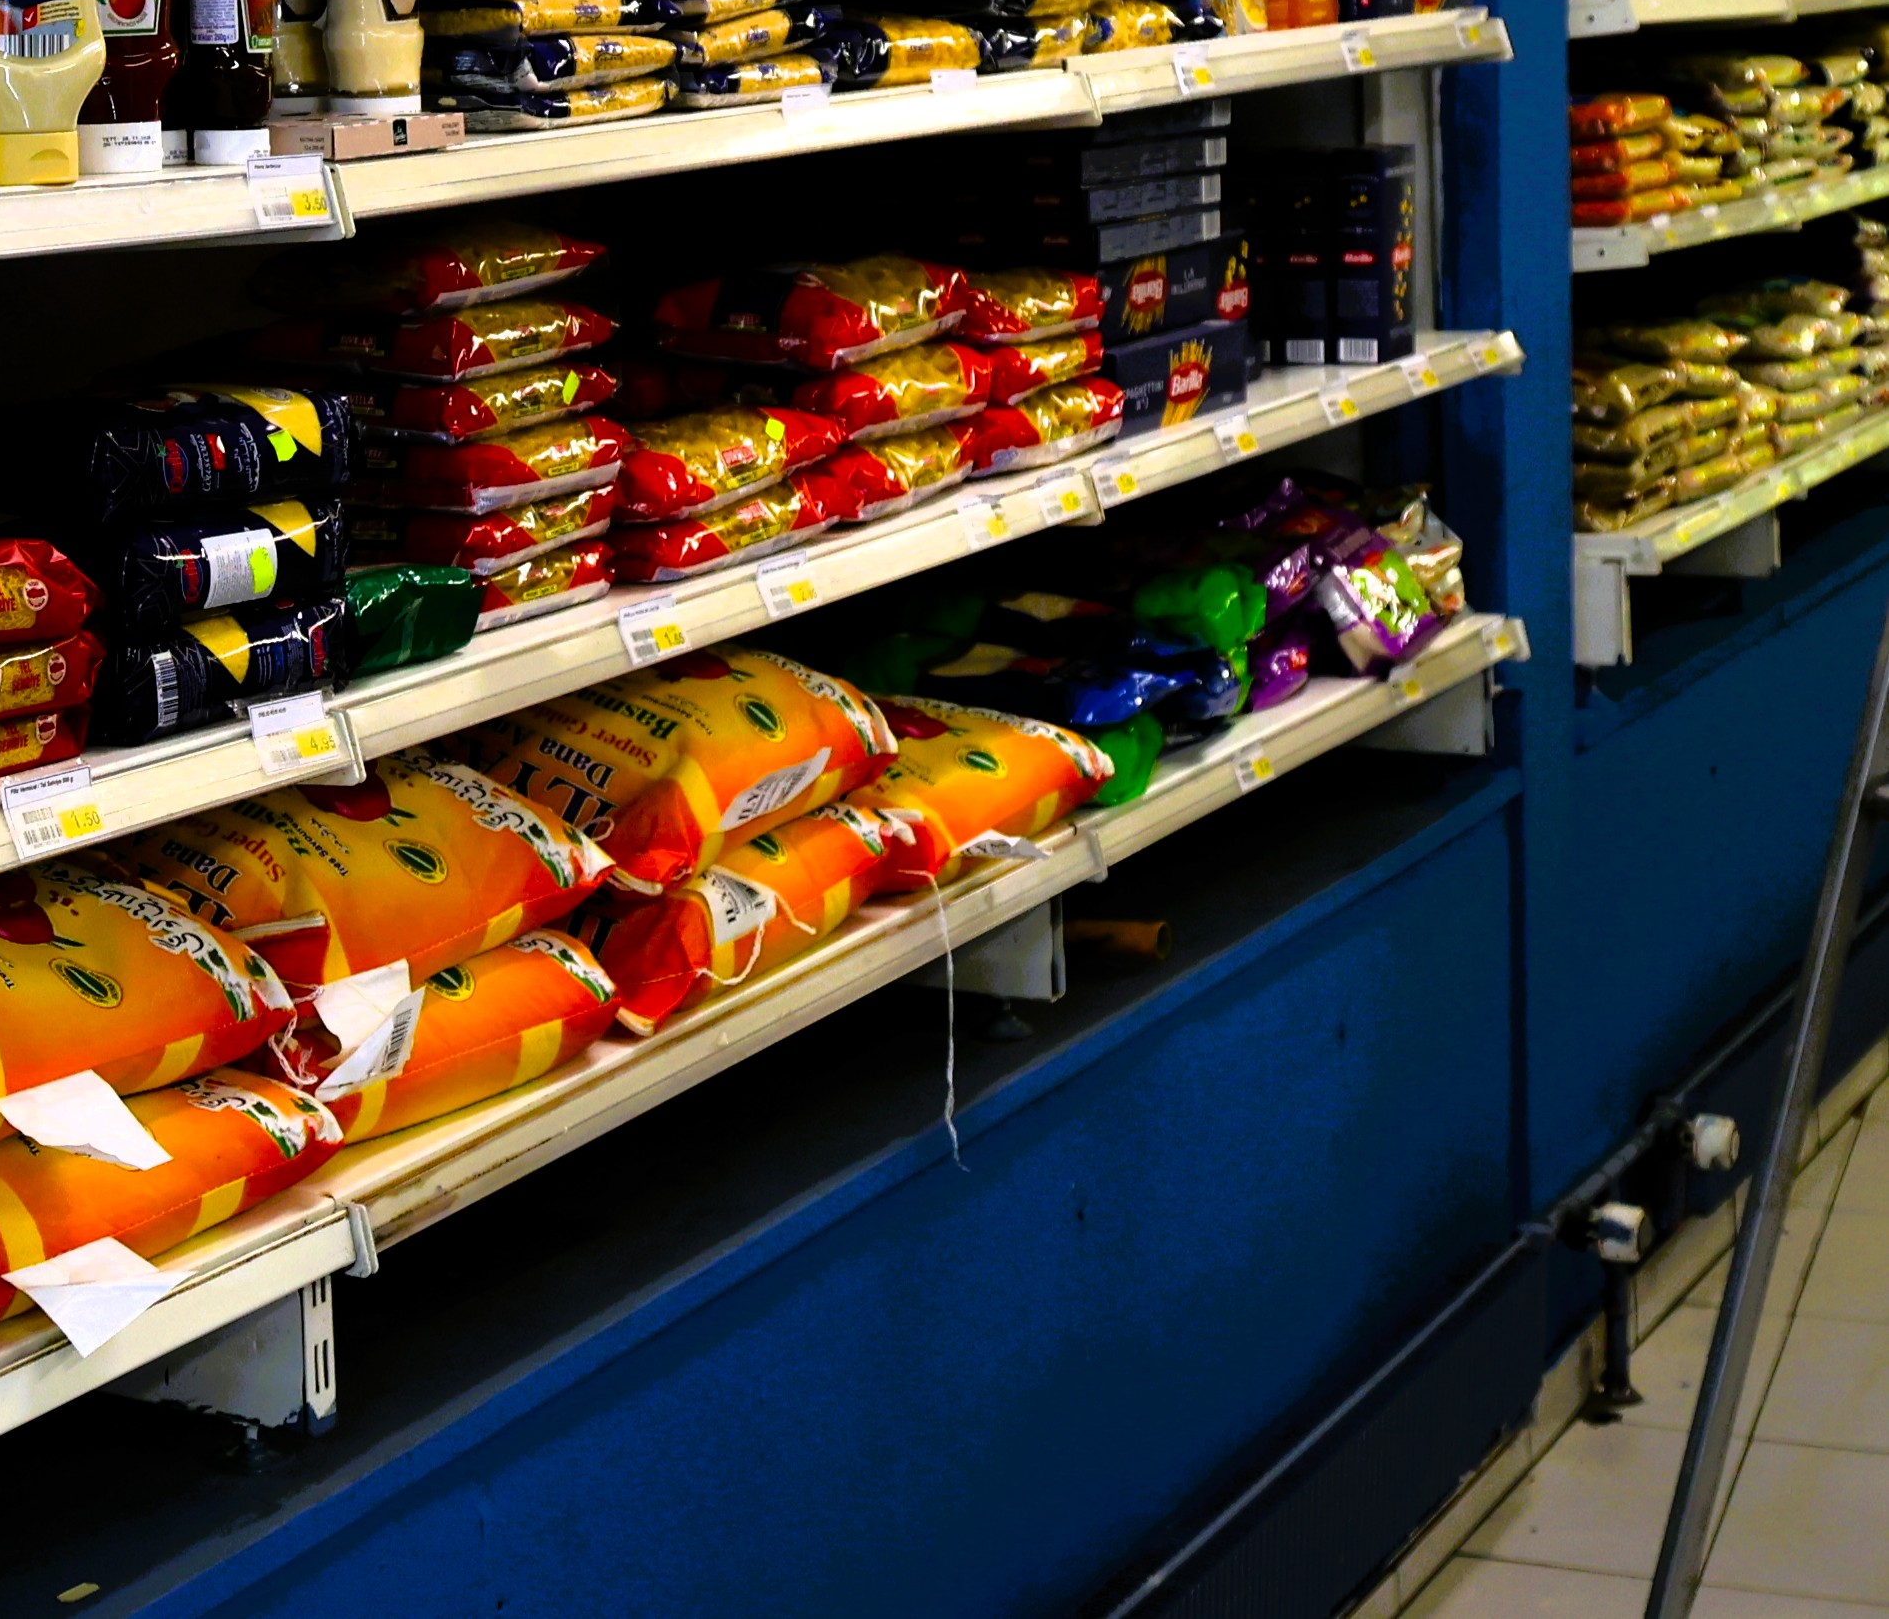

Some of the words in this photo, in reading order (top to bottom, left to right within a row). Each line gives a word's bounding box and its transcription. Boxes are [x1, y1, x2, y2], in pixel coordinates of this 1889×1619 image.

[304, 192, 328, 212] 3.50
[310, 734, 336, 753] 4.95
[539, 737, 614, 792] Dana
[591, 724, 659, 770] Super
[73, 809, 101, 829] 1.50
[161, 838, 241, 896] Dana
[222, 829, 286, 884] Super
